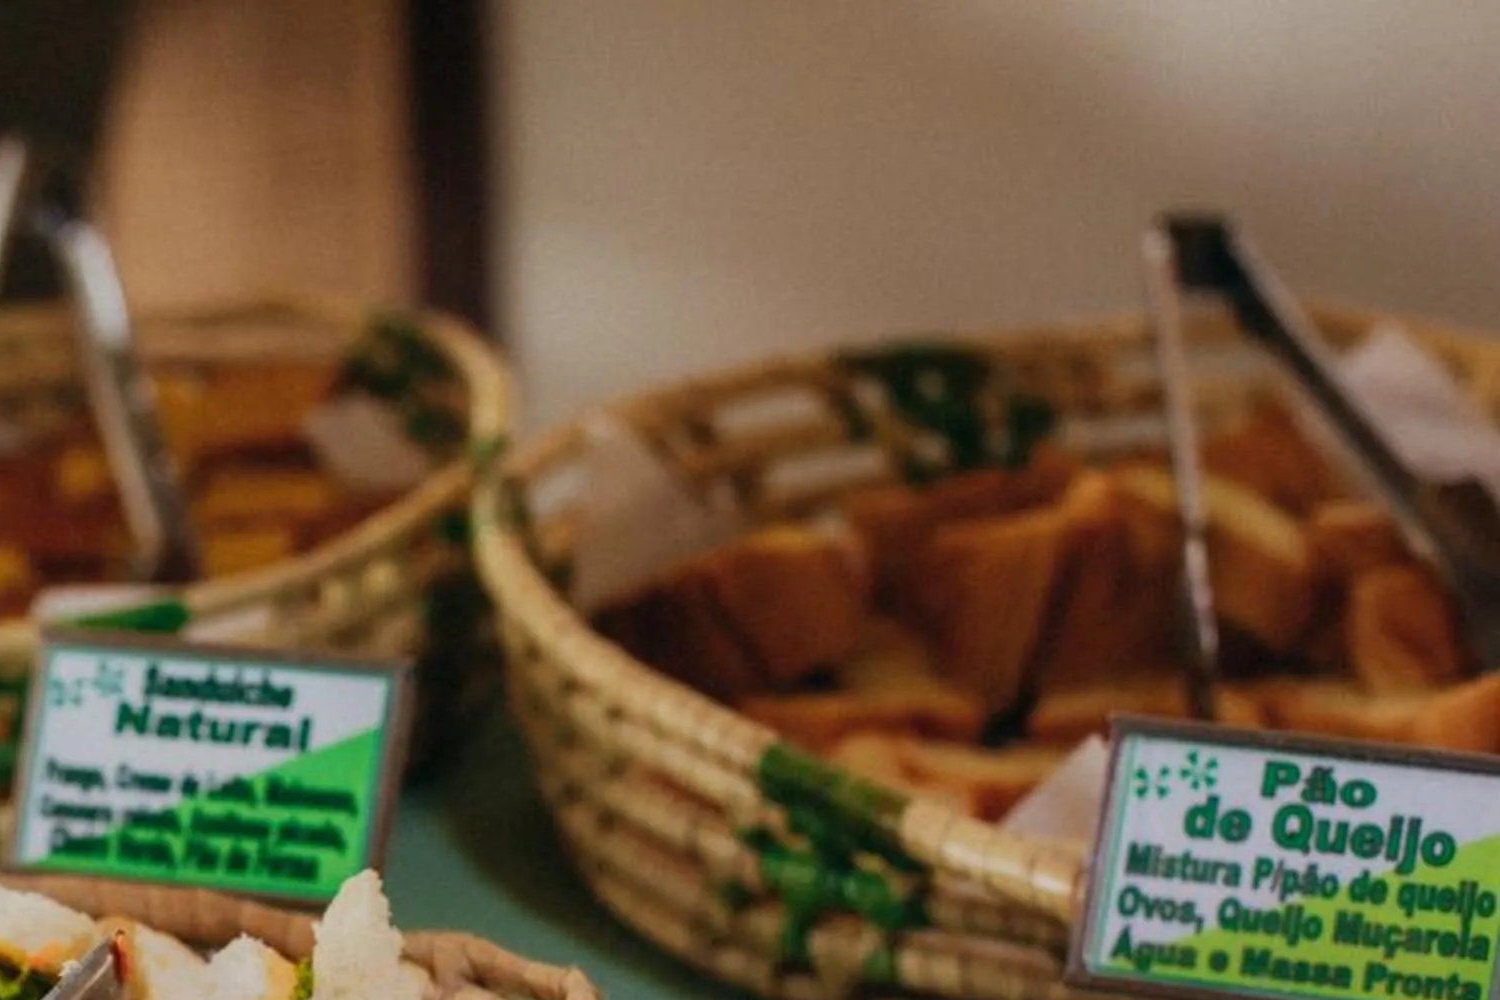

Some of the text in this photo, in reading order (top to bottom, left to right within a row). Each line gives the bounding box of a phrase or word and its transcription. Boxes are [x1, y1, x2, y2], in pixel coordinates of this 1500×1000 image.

[115, 702, 312, 751] Natural
[1261, 760, 1378, 808] Pão
[1184, 794, 1457, 875] de Queijo
[1125, 842, 1242, 887] Mistura
[1349, 870, 1389, 905] de
[1397, 880, 1497, 926] queijo
[1118, 885, 1490, 961] Ovos, Queijo Muçarela
